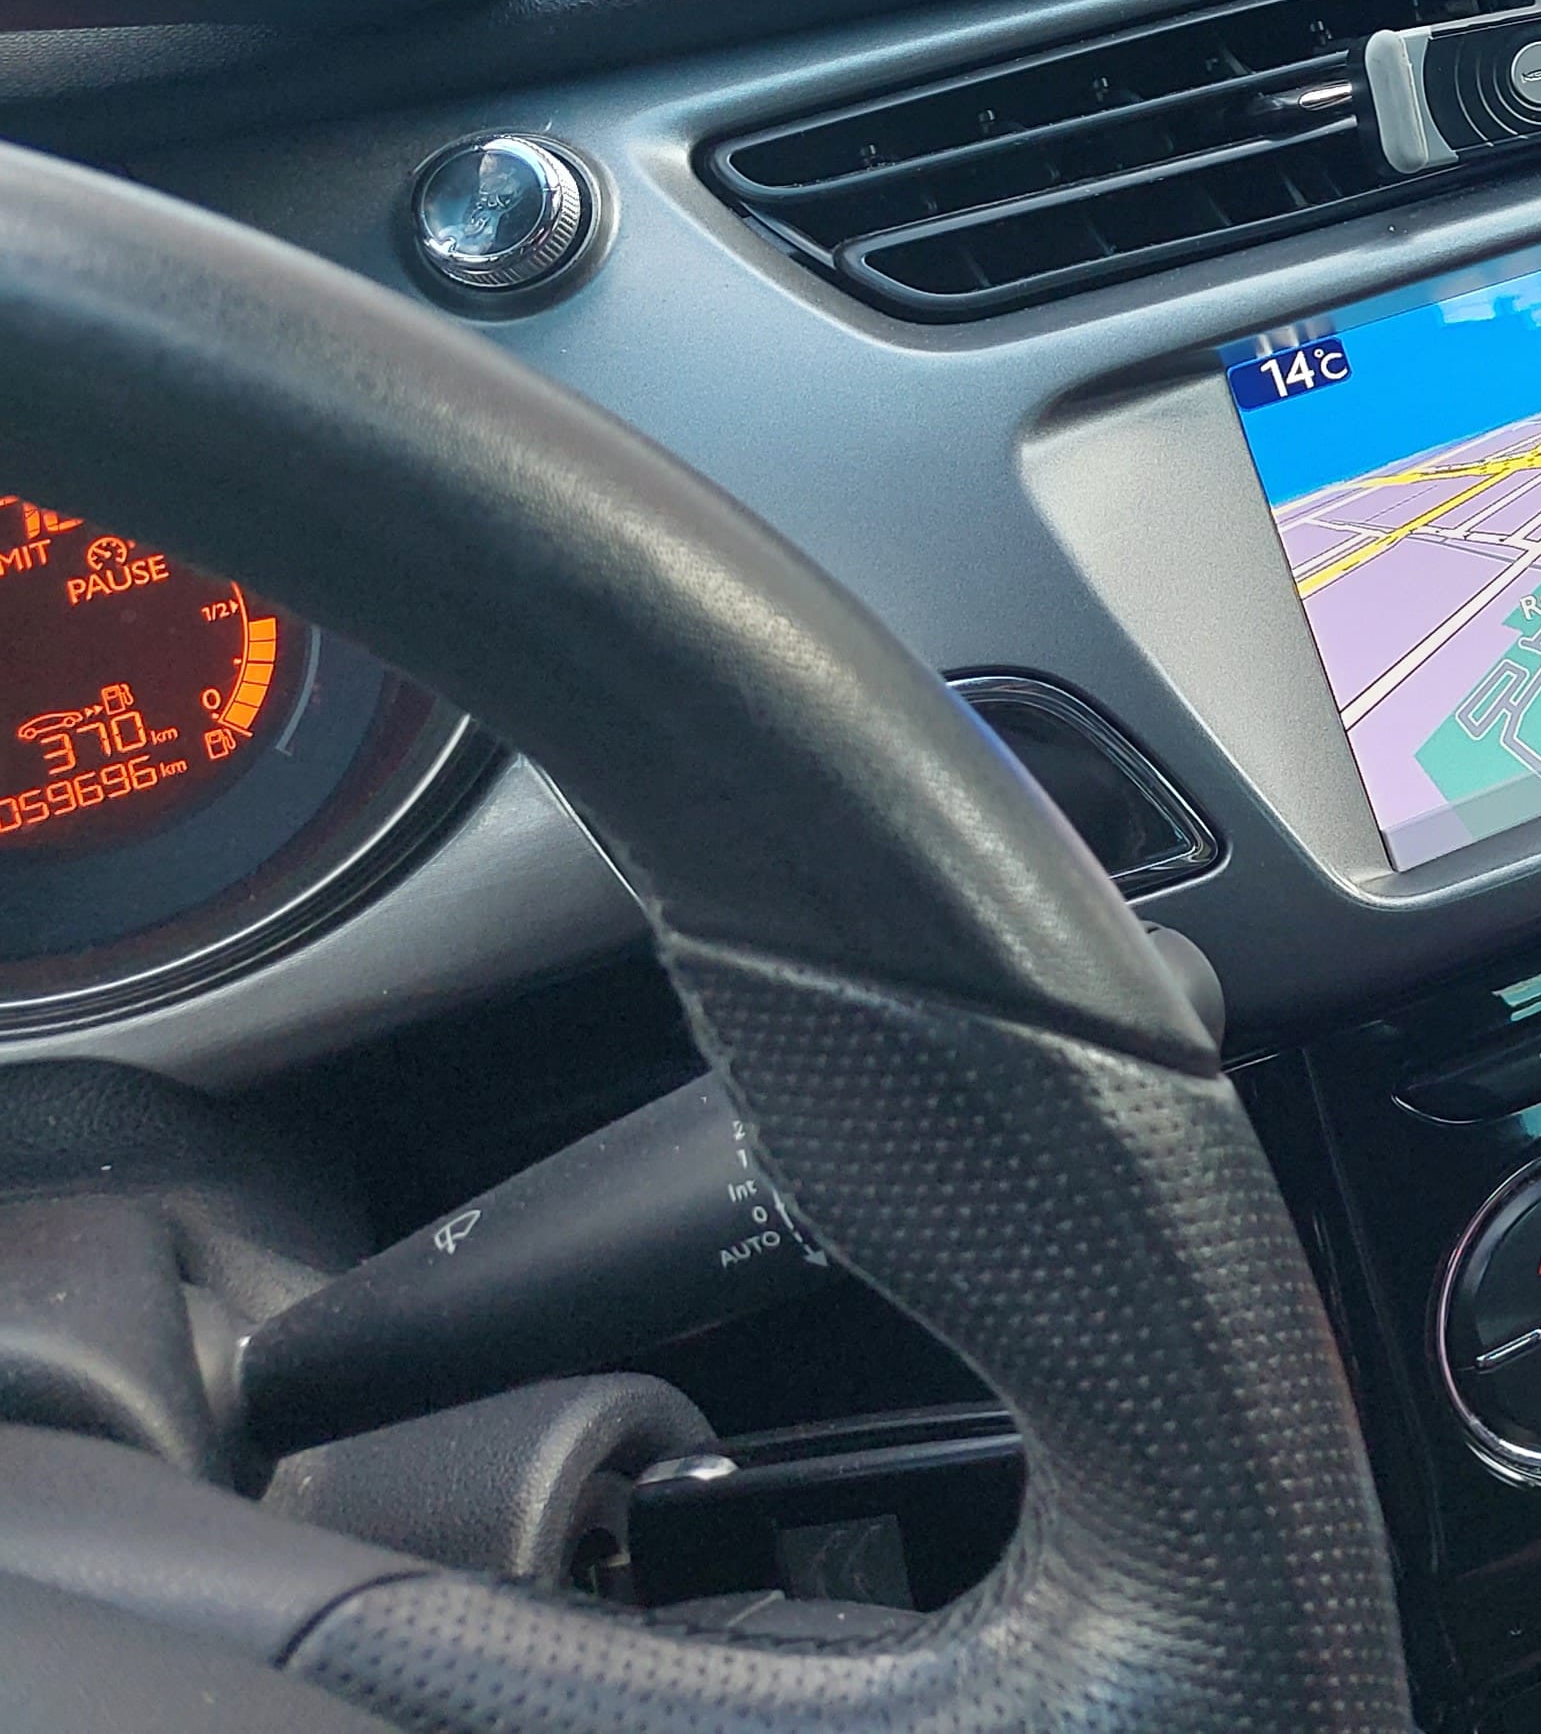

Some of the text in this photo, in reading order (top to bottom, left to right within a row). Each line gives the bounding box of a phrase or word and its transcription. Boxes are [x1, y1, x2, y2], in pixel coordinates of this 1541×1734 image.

[67, 555, 170, 606] PAUSE
[201, 601, 231, 623] 1/2
[202, 688, 222, 710] 0
[40, 711, 179, 775] 370 km
[160, 760, 188, 779] km
[727, 1178, 758, 1203] Int
[719, 1230, 781, 1269] AUTO
